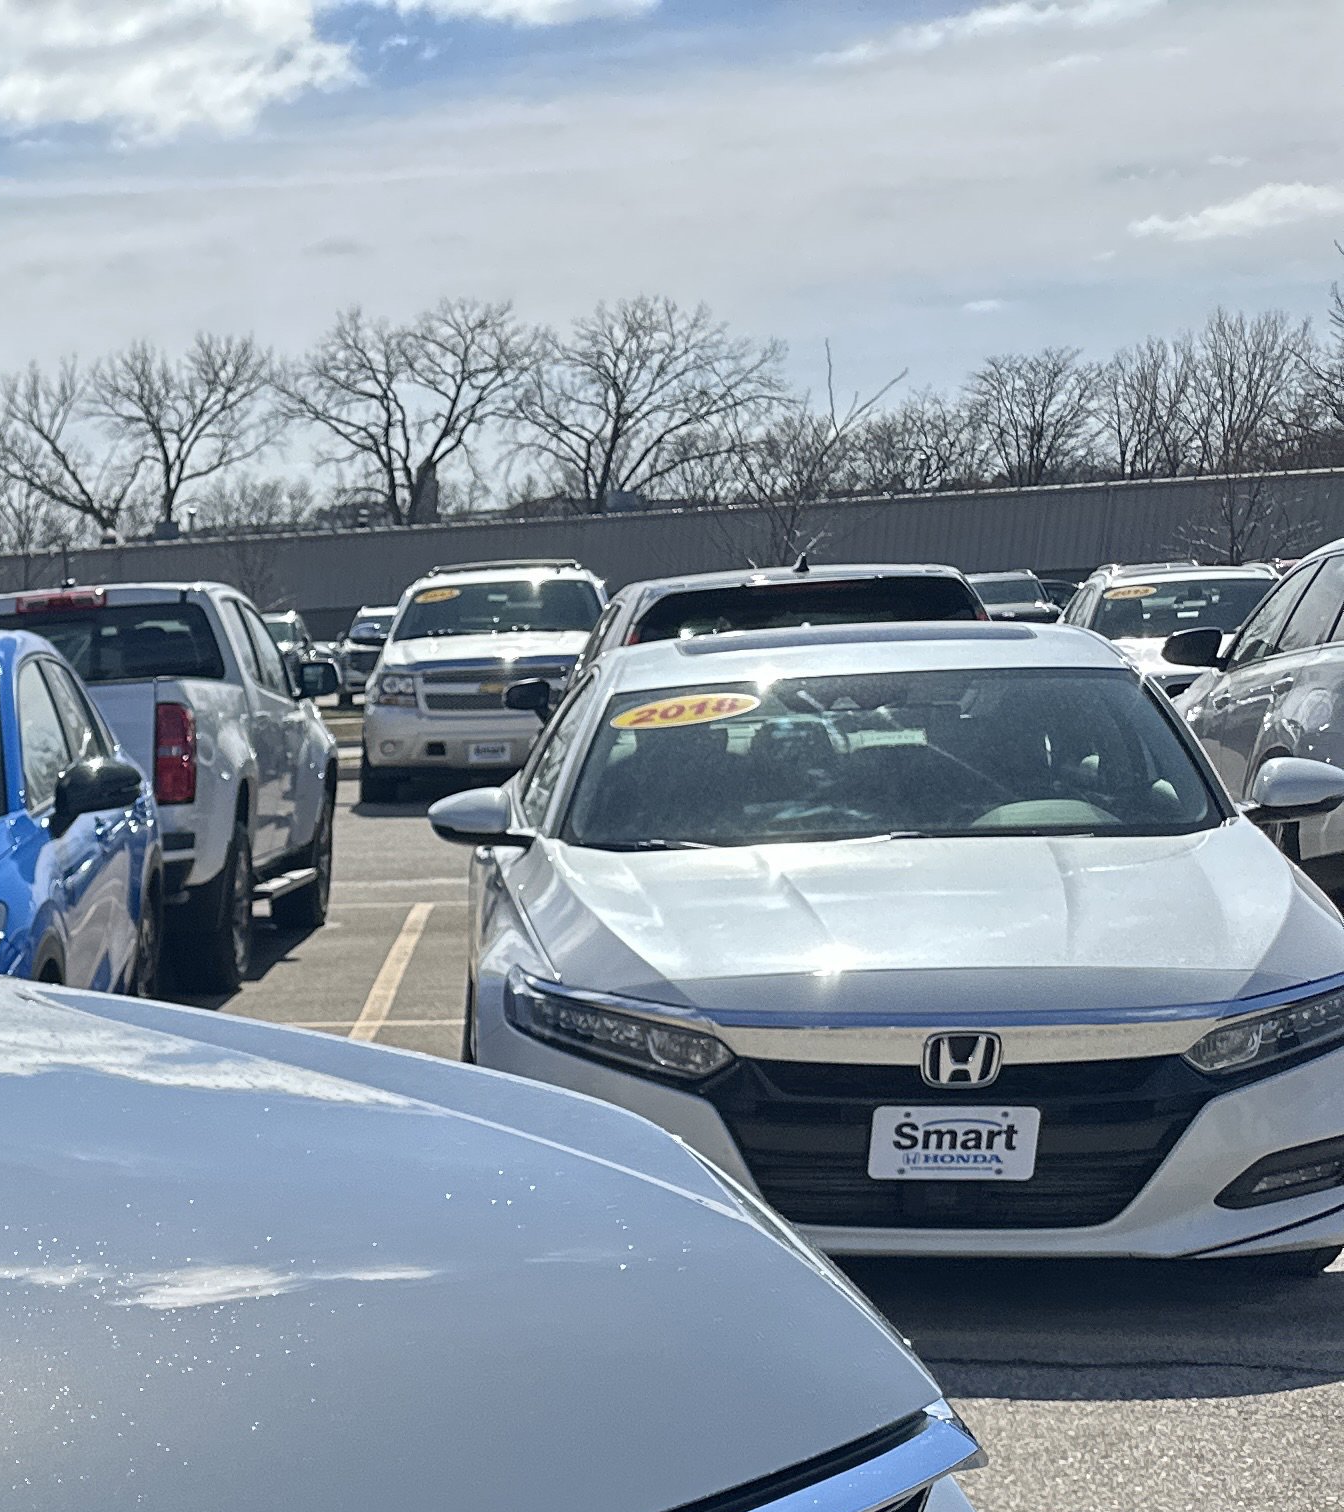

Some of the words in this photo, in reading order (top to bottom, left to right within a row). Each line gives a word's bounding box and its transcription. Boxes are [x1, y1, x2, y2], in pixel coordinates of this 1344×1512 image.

[628, 697, 739, 726] 2018
[892, 1121, 1018, 1151] Smart
[922, 1153, 1003, 1165] HONDA
